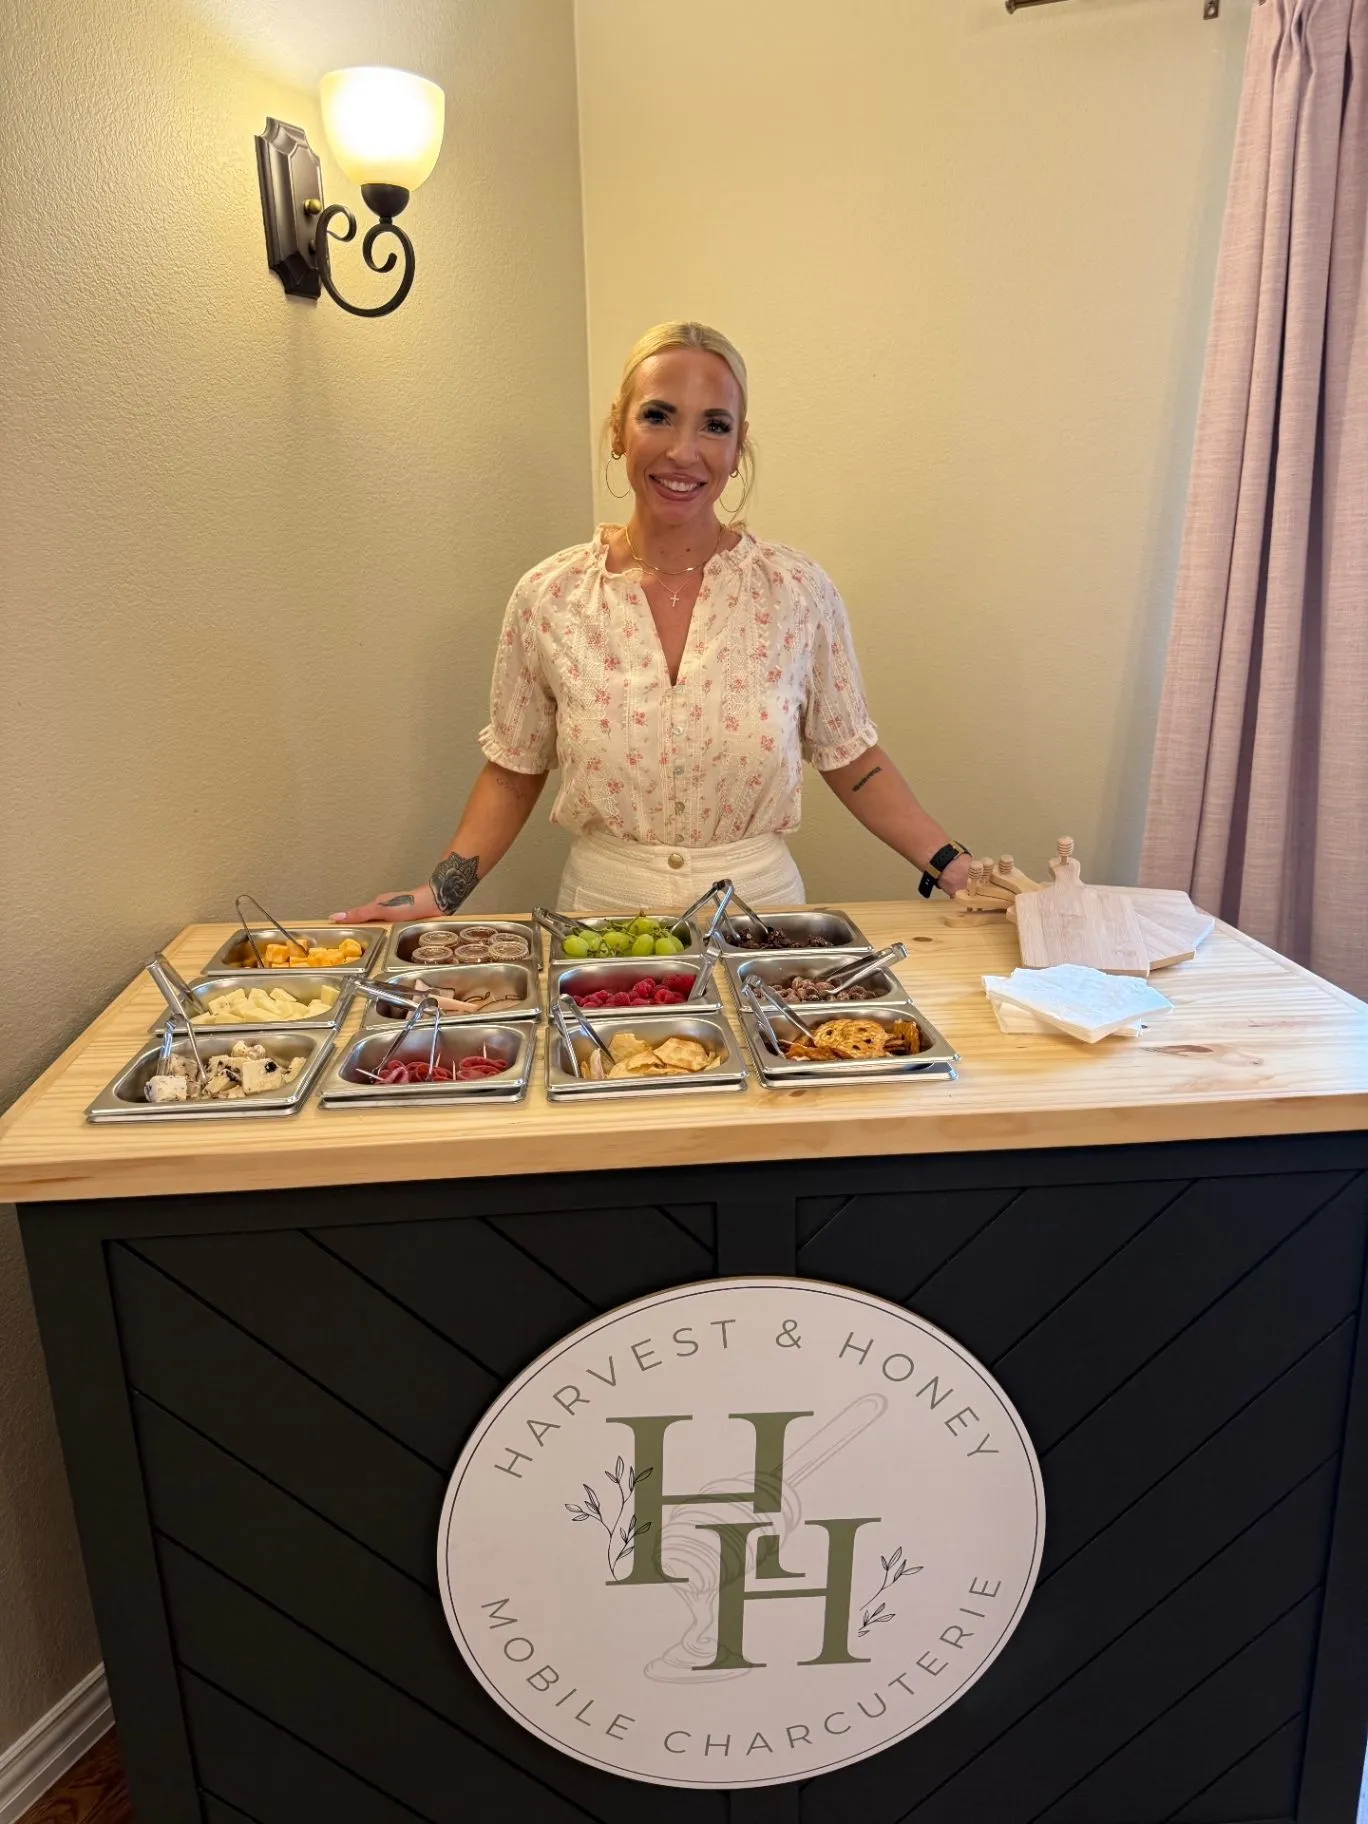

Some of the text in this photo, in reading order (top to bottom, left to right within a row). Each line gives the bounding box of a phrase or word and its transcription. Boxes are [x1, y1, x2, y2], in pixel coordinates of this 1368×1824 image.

[494, 1319, 999, 1478] HARVEST & HONEY
[480, 1576, 1001, 1757] MOBILE CHARCUTERIE
